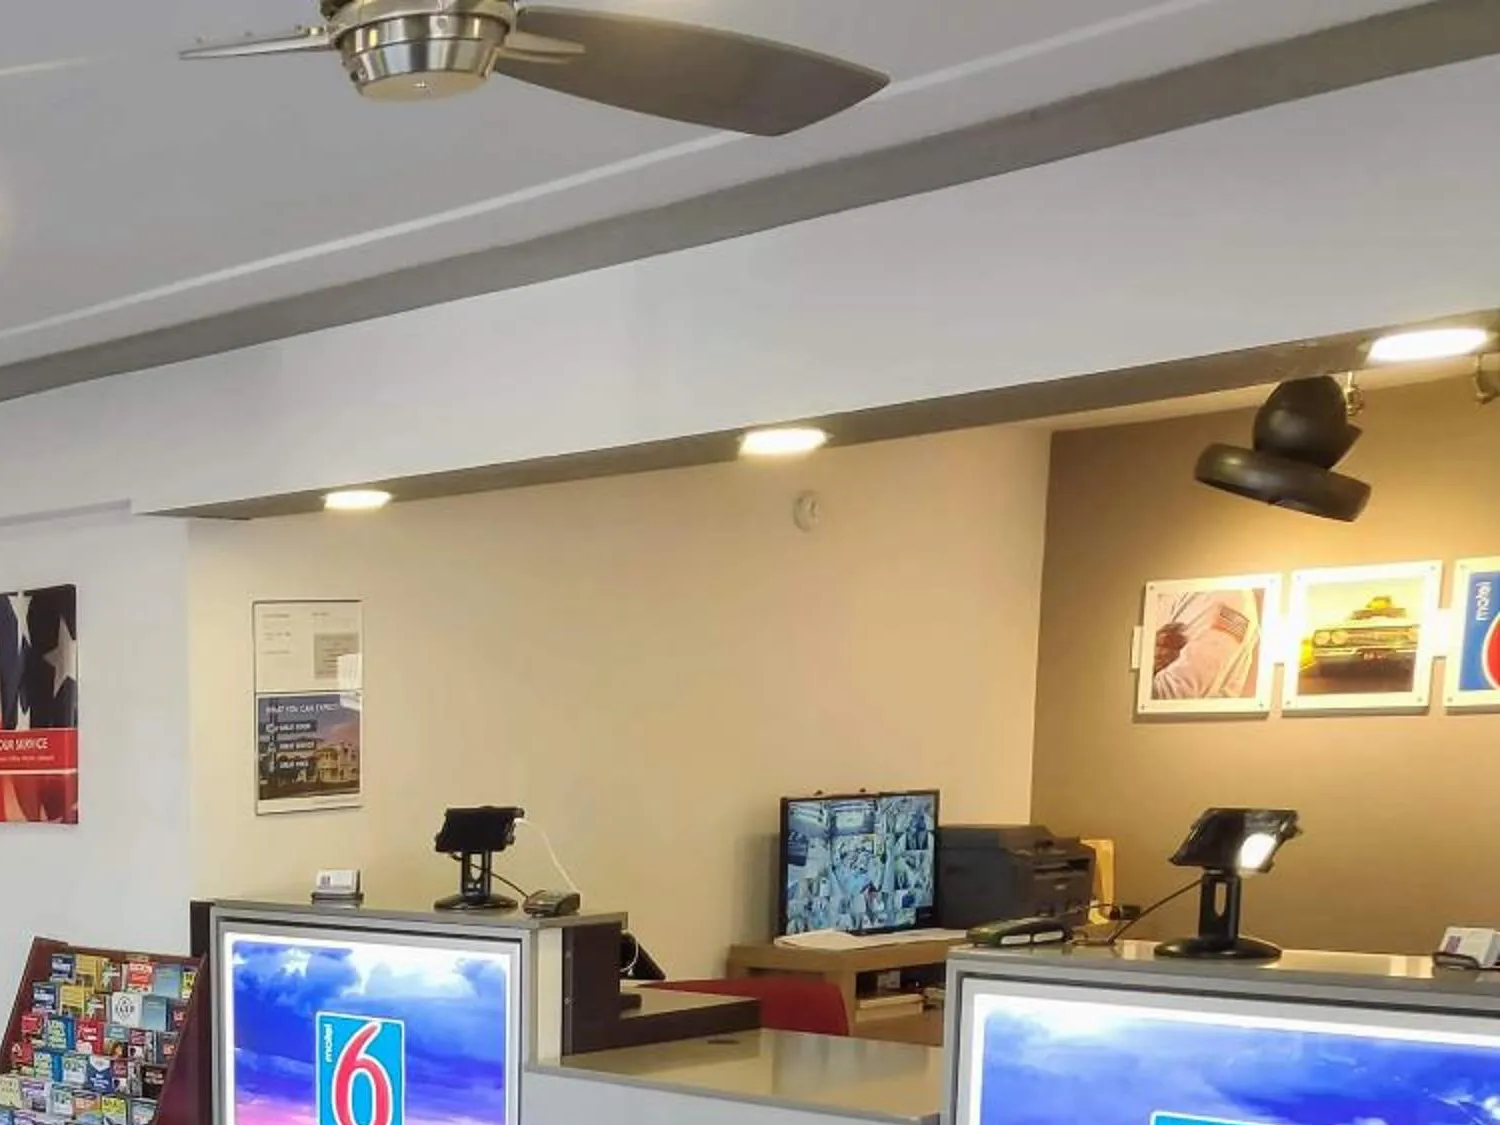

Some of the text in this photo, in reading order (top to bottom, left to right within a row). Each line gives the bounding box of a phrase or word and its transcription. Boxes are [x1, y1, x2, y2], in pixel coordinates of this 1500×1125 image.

[1474, 581, 1492, 622] motel
[15, 738, 49, 750] SERVICE
[323, 1023, 333, 1063] motel
